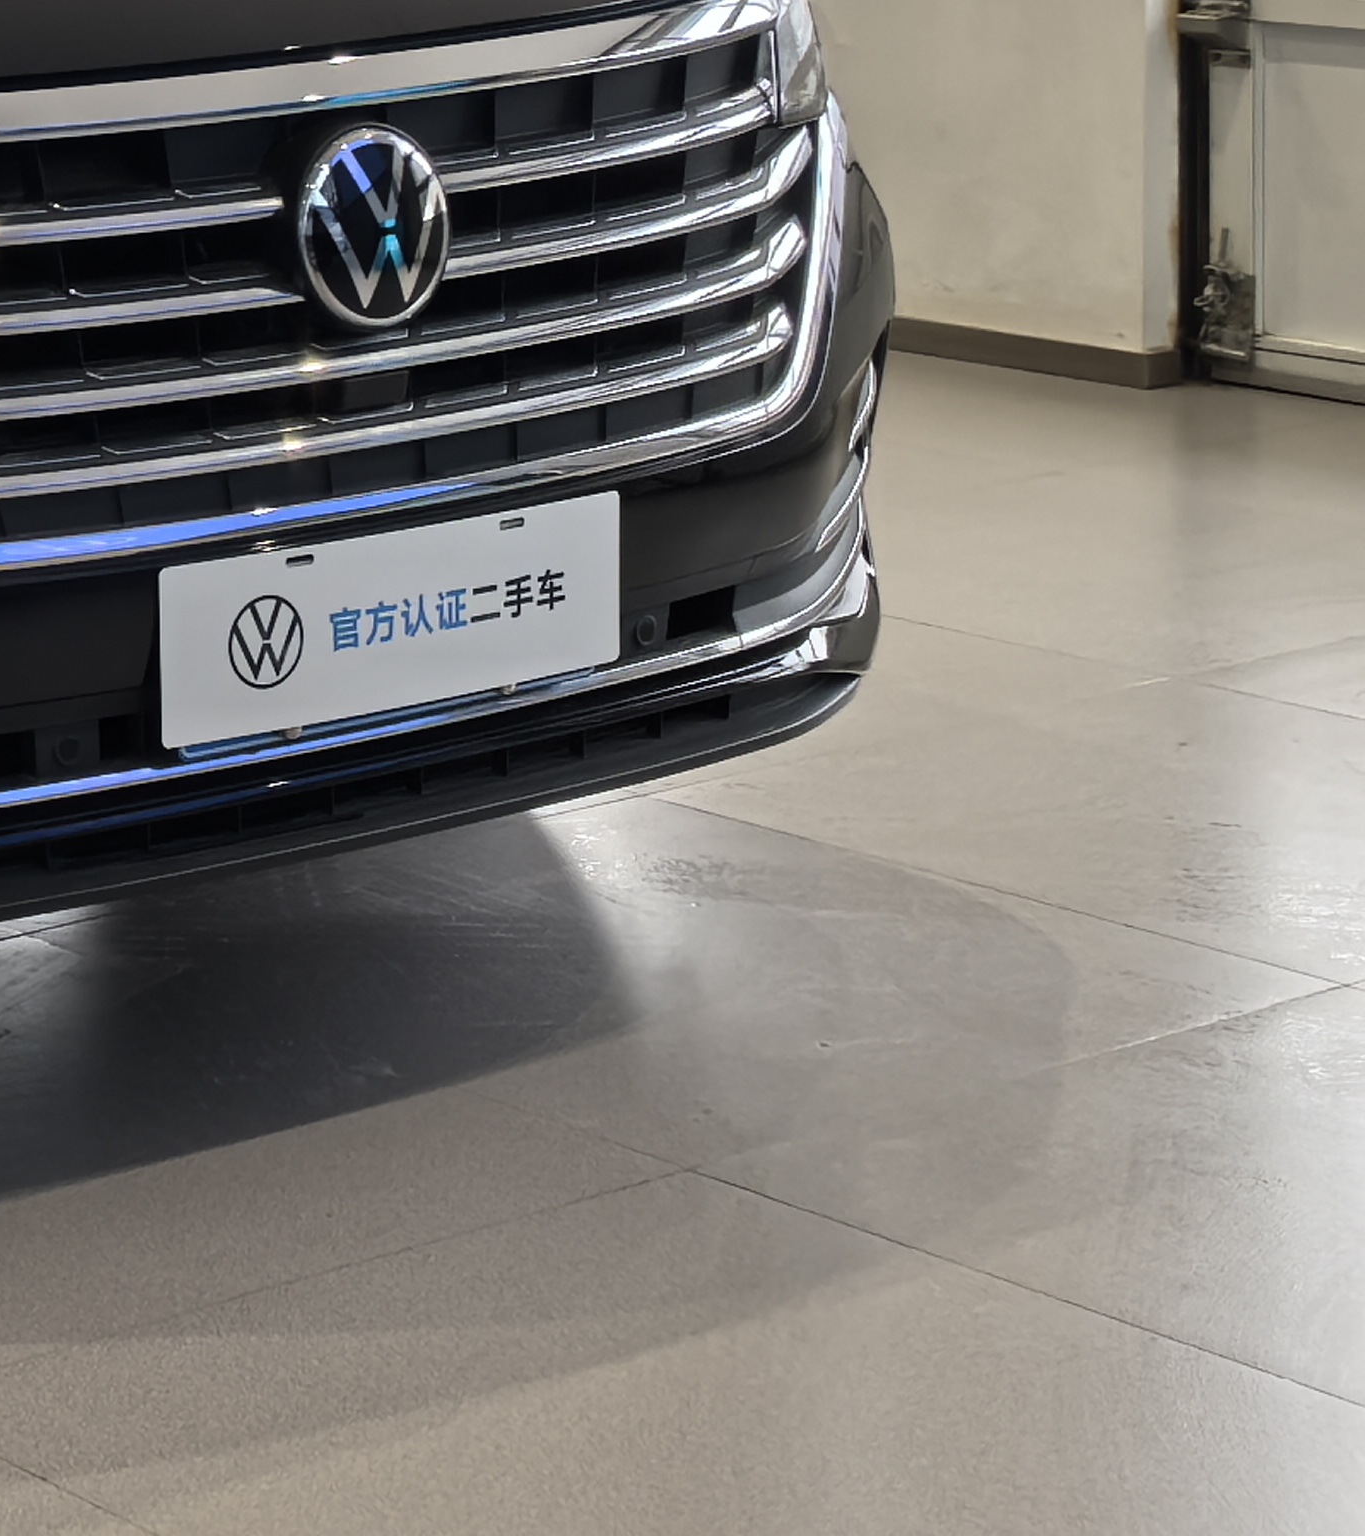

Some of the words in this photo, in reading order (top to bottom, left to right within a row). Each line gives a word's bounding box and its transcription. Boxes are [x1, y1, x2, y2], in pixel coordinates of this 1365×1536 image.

[228, 594, 304, 690] VW
[329, 569, 566, 652] 官方认证二手车
